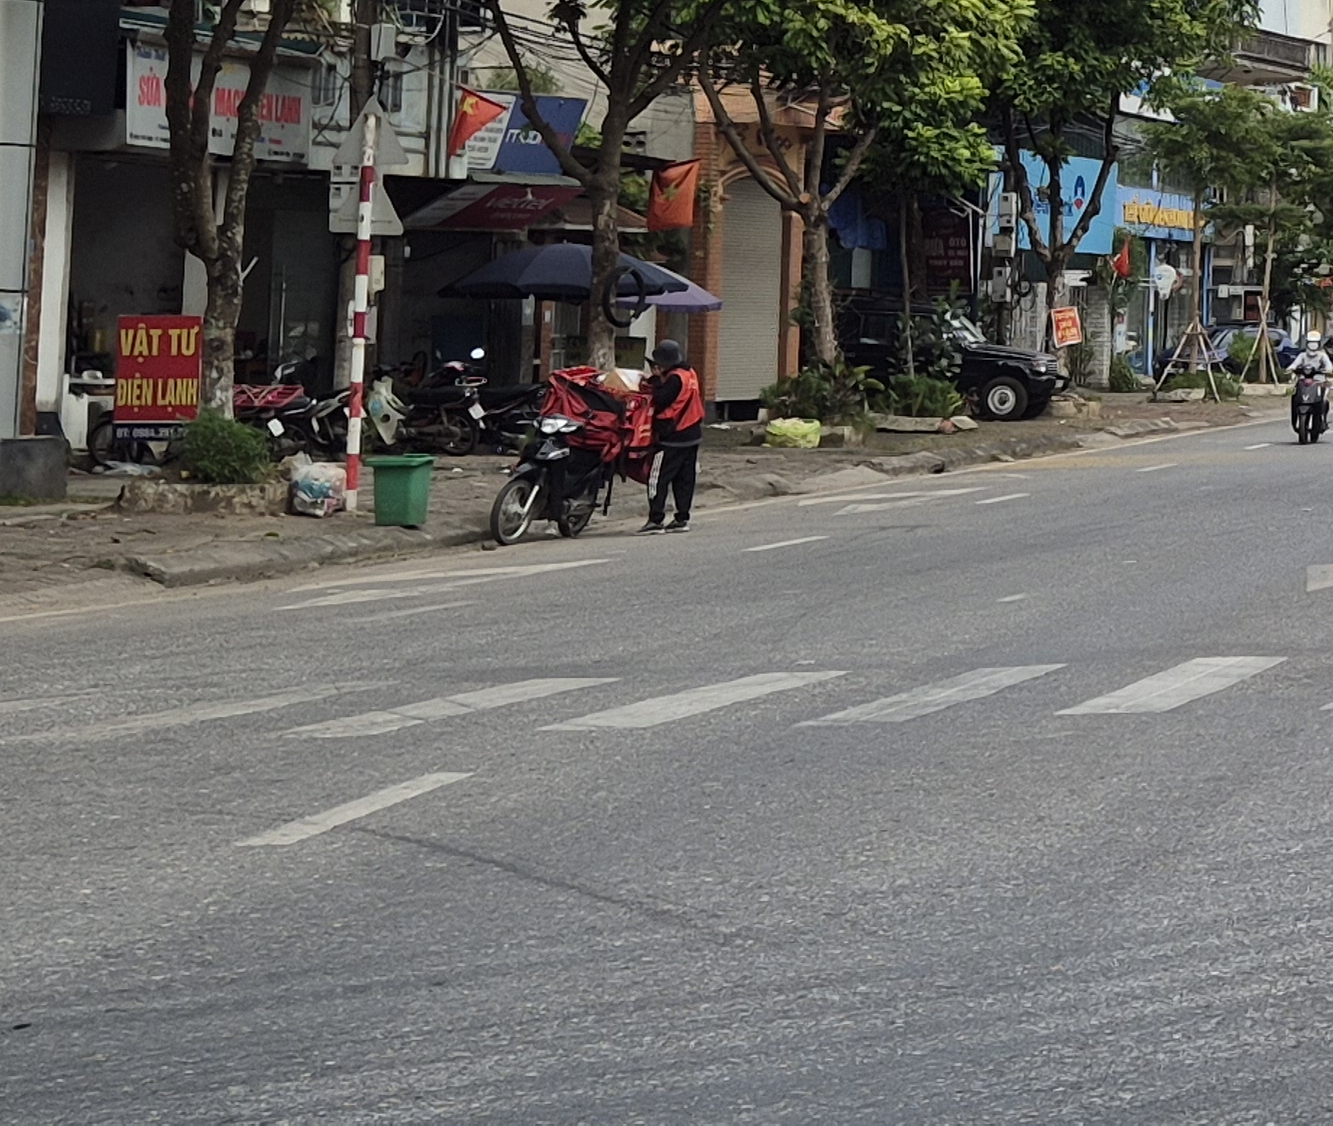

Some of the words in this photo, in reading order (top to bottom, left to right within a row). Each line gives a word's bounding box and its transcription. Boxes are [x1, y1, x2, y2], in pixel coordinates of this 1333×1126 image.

[120, 323, 162, 363] VẬT
[168, 325, 200, 356] TƯ
[116, 372, 154, 412] ĐIỆN
[156, 377, 198, 412] LẠNH
